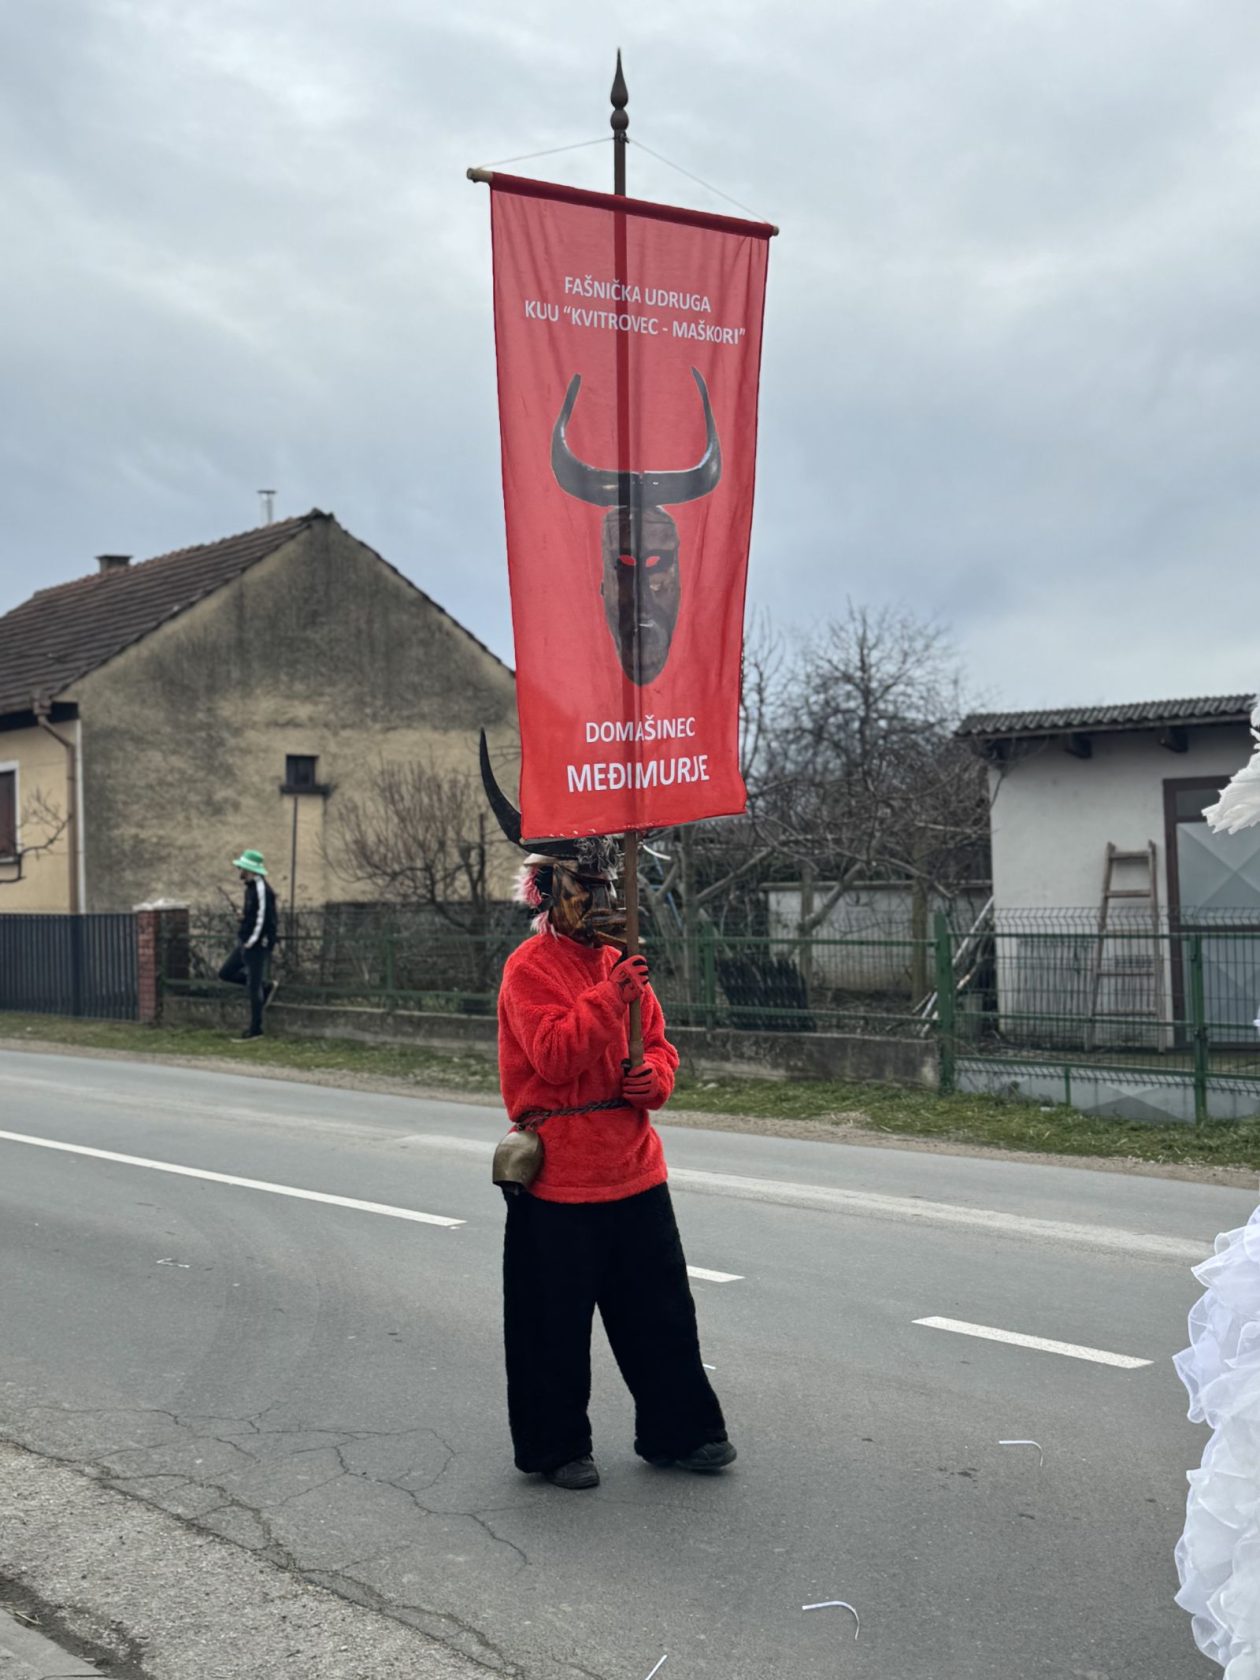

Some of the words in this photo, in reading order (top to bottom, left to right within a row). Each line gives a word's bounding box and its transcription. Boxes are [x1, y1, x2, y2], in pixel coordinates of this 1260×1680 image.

[564, 274, 641, 303] FAŠNIČKA
[645, 288, 711, 312] UDRUGA
[525, 300, 559, 322] KUU
[585, 714, 696, 743] DOMAŠINEC
[567, 754, 710, 793] MEĐIMURJE
